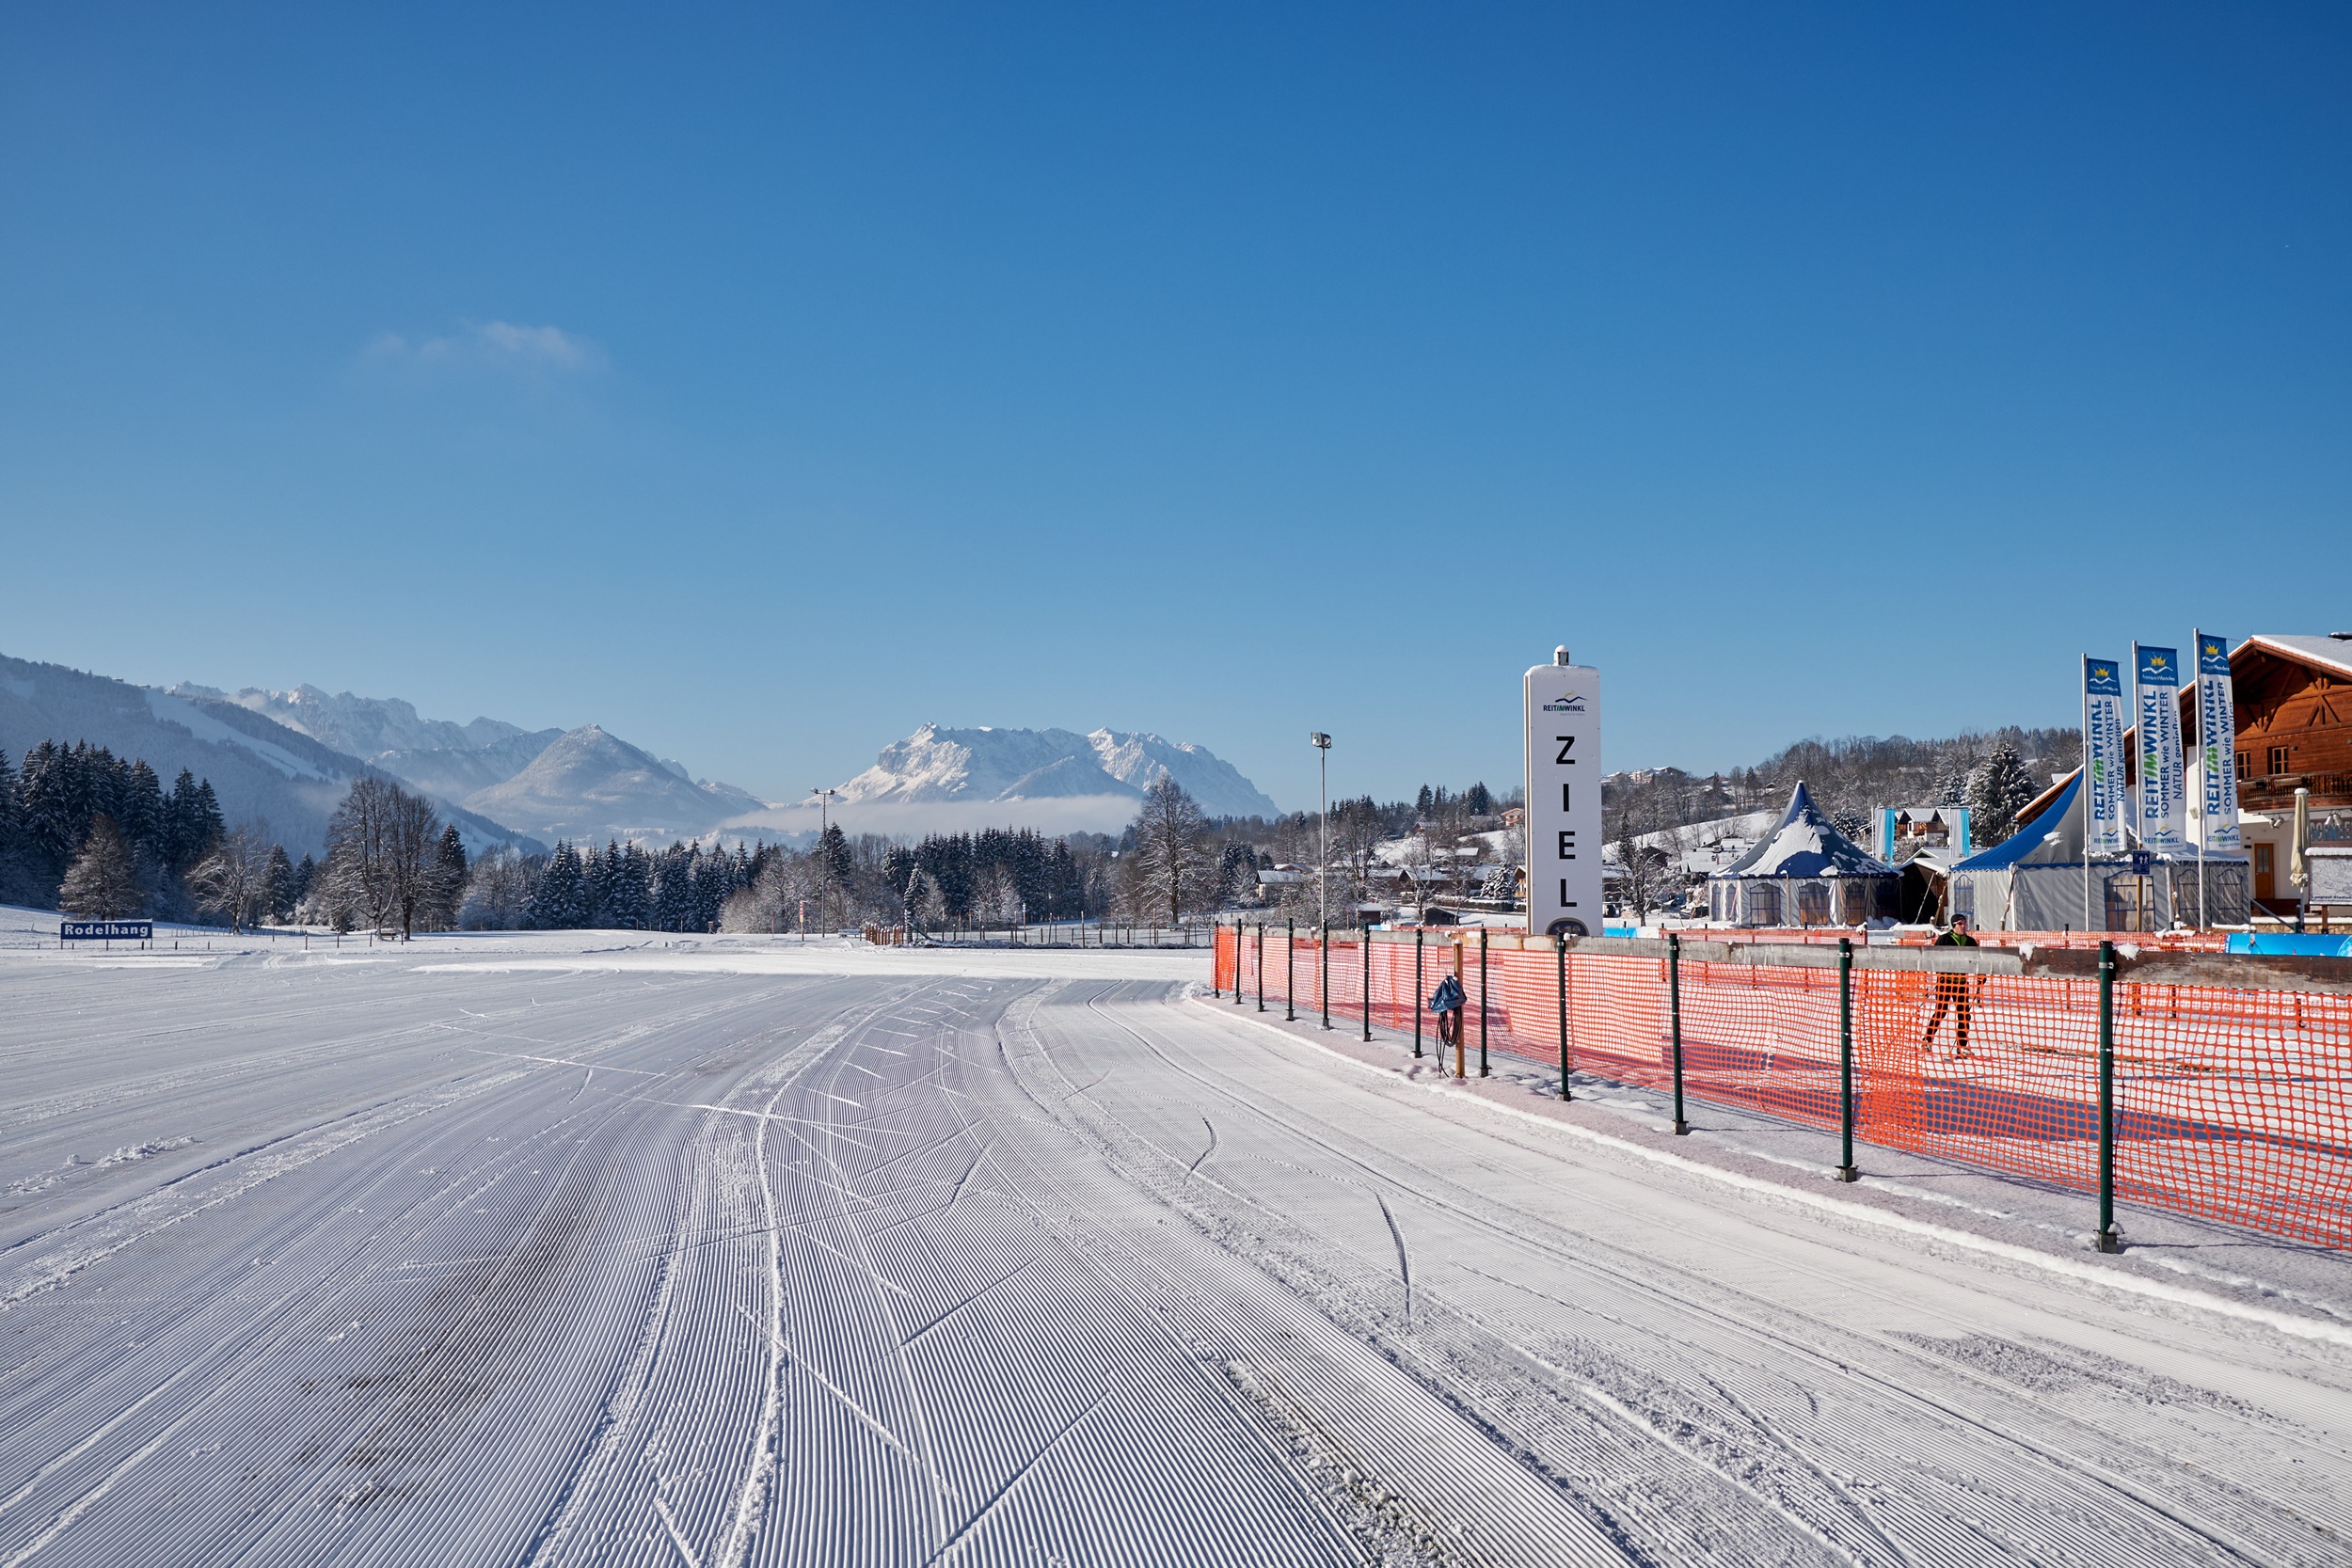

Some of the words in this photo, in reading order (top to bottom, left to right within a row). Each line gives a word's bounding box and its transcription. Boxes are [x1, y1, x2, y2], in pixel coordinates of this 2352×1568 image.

[2105, 700, 2114, 749] WINTER
[2159, 691, 2169, 743] WINTER
[2217, 681, 2229, 735] WINTER
[2091, 700, 2106, 821] REITIMWINKL
[2143, 690, 2159, 818] REITIMWINKL
[2161, 745, 2169, 763] wie
[2204, 680, 2220, 816] REITIMWINKL
[2222, 736, 2231, 755] wie
[2116, 765, 2125, 801] NATUR
[2160, 765, 2169, 819] SOMMER
[2172, 761, 2183, 800] NATUR
[2223, 759, 2233, 815] SOMMER
[1555, 736, 1578, 908] ZIEL
[64, 924, 149, 937] Rodelhang
